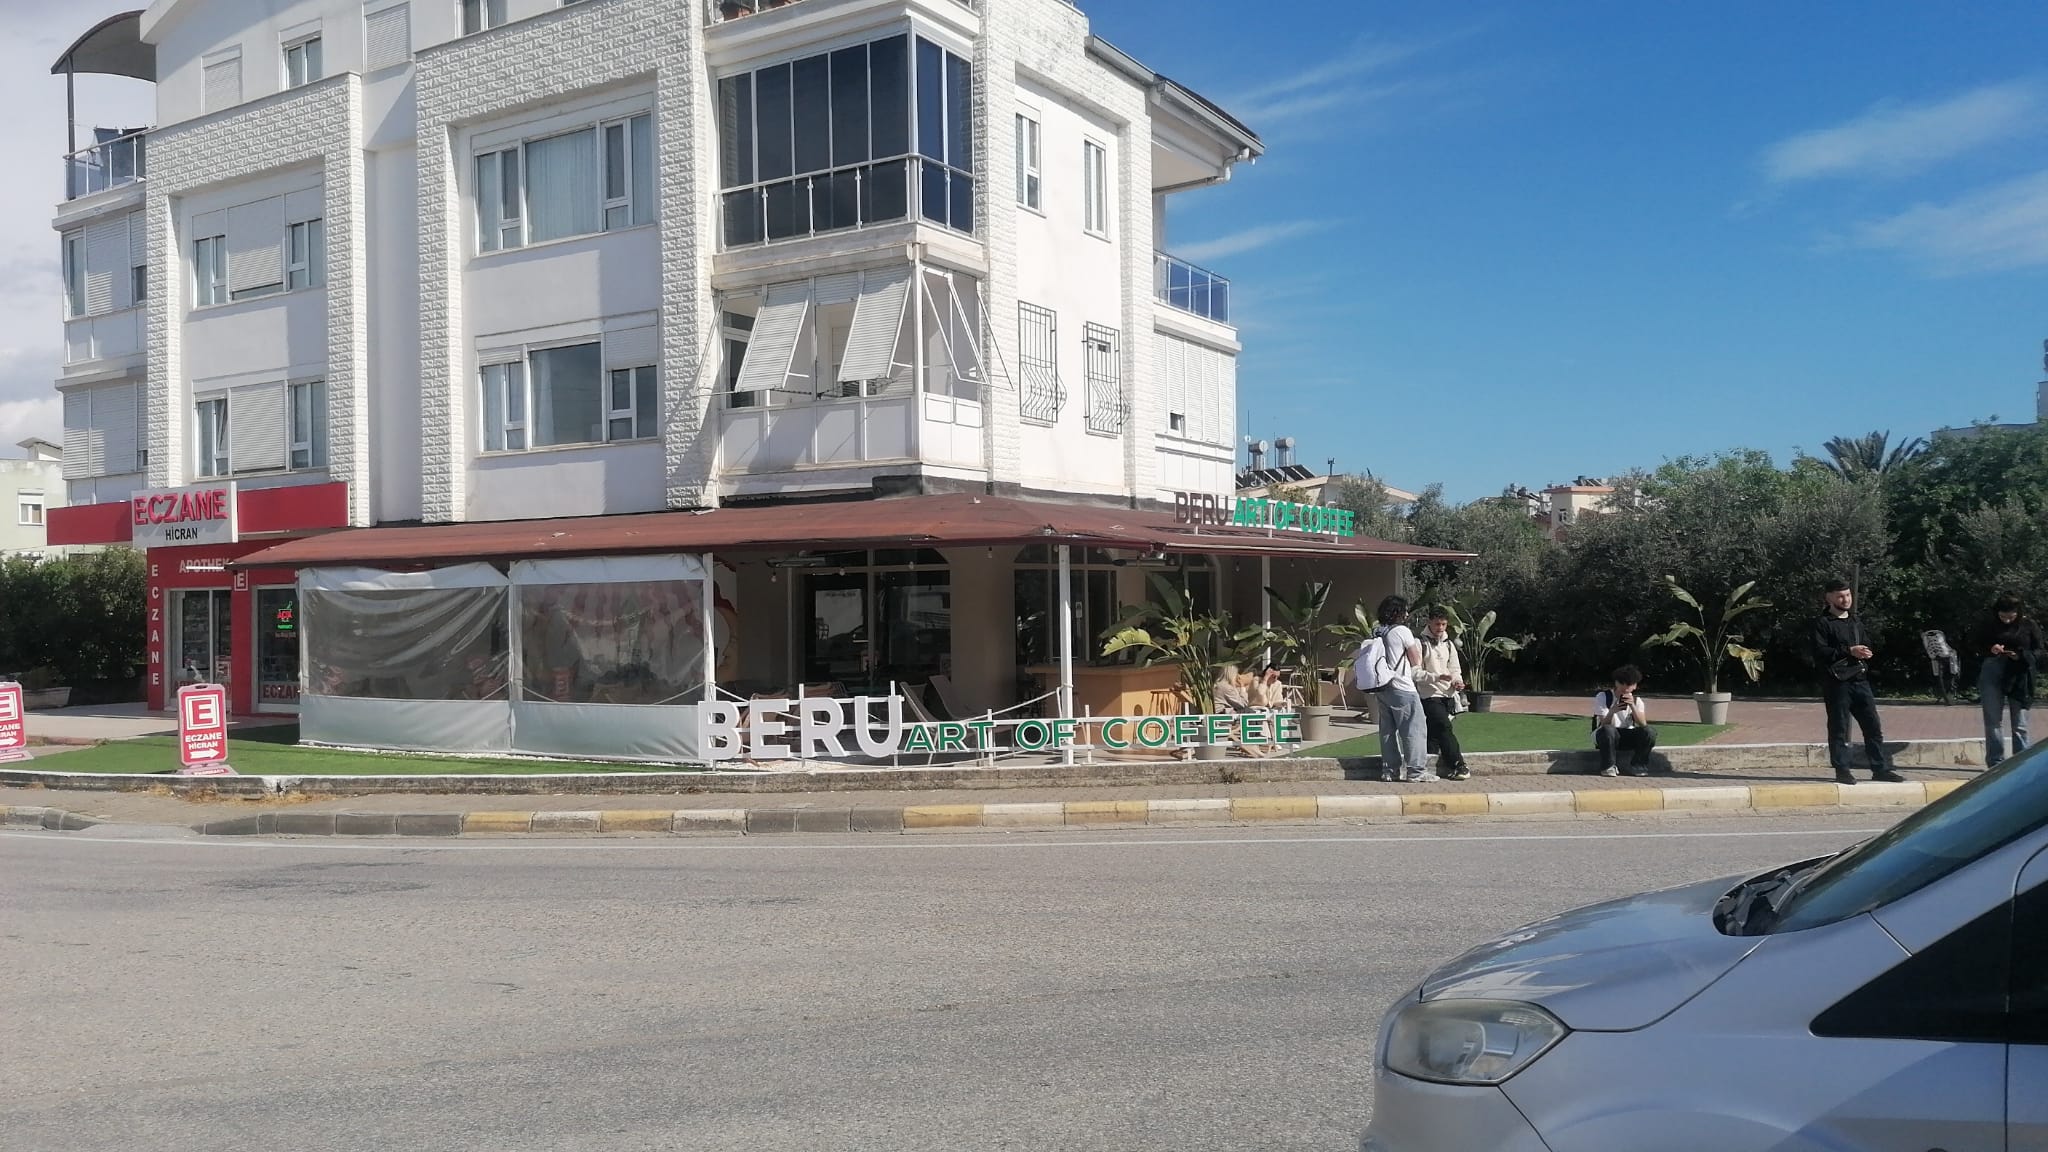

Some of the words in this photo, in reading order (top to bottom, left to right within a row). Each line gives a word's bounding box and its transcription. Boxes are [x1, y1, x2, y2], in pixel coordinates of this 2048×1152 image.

[134, 488, 228, 525] ECZANE
[1174, 491, 1228, 526] BERU
[1232, 496, 1268, 529] ART
[1274, 500, 1296, 530] OF
[1300, 504, 1355, 537] COFFEE
[165, 526, 198, 540] HİCRAN
[237, 572, 245, 588] E
[151, 564, 159, 685] ECZANE
[191, 699, 214, 725] E
[185, 732, 222, 743] ECZANE
[698, 695, 903, 760] BERU
[904, 721, 994, 753] ART
[1015, 718, 1078, 751] OF
[1102, 713, 1302, 749] COFFEE
[188, 741, 218, 750] HİCRAN
